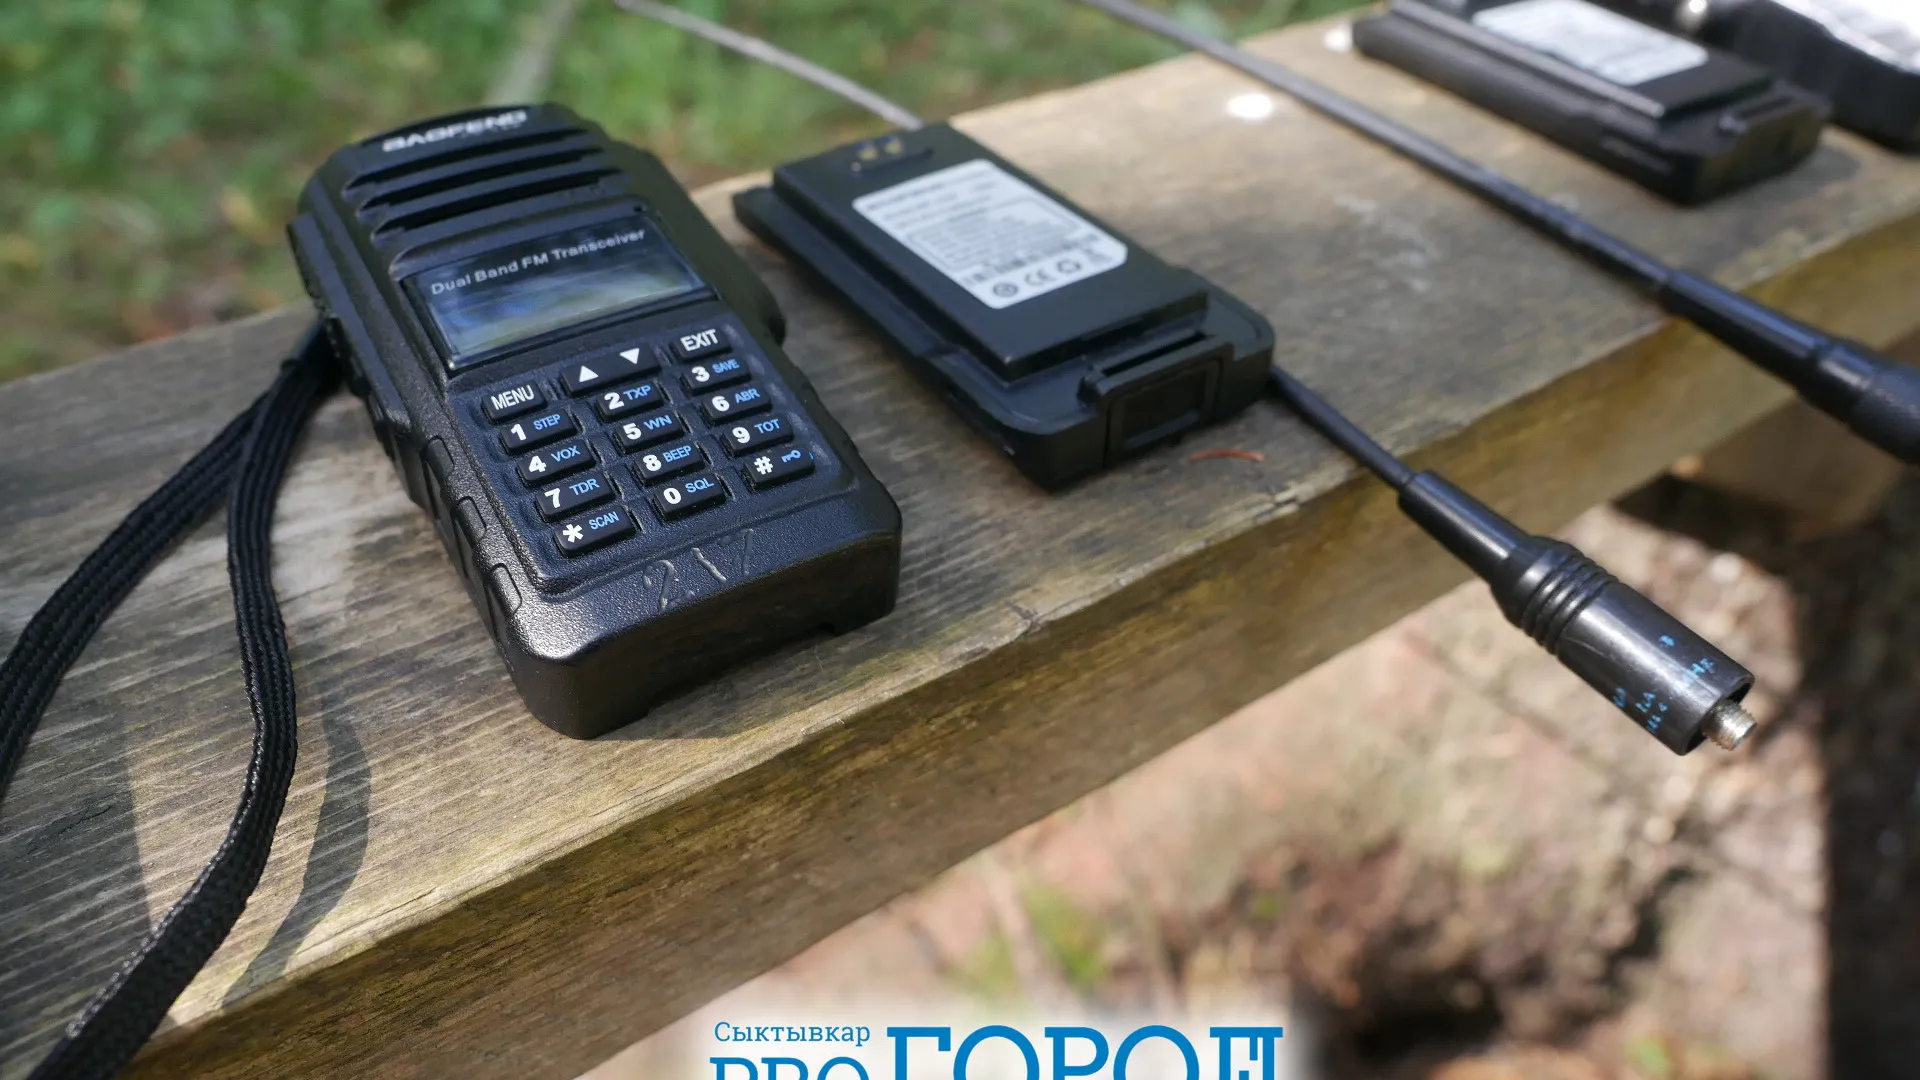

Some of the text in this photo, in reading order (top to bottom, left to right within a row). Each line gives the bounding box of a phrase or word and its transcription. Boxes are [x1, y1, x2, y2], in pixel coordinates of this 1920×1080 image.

[431, 228, 646, 296] Dual Band FM Transceiver
[680, 328, 719, 352] EXIT
[691, 358, 740, 382] 3 SAVE
[490, 384, 535, 411] MENU
[604, 384, 651, 410] 2 TXP
[711, 388, 761, 412] 6 ABR
[510, 413, 561, 441] 1 STEP
[623, 415, 673, 440] 5 WN
[732, 418, 781, 444] 9 TOT
[528, 445, 581, 474] 4 VOX
[642, 445, 692, 472] 8 BEEP
[544, 478, 599, 508] 7 TDR
[663, 477, 715, 504] 0 SQL
[588, 511, 620, 531] SCAN
